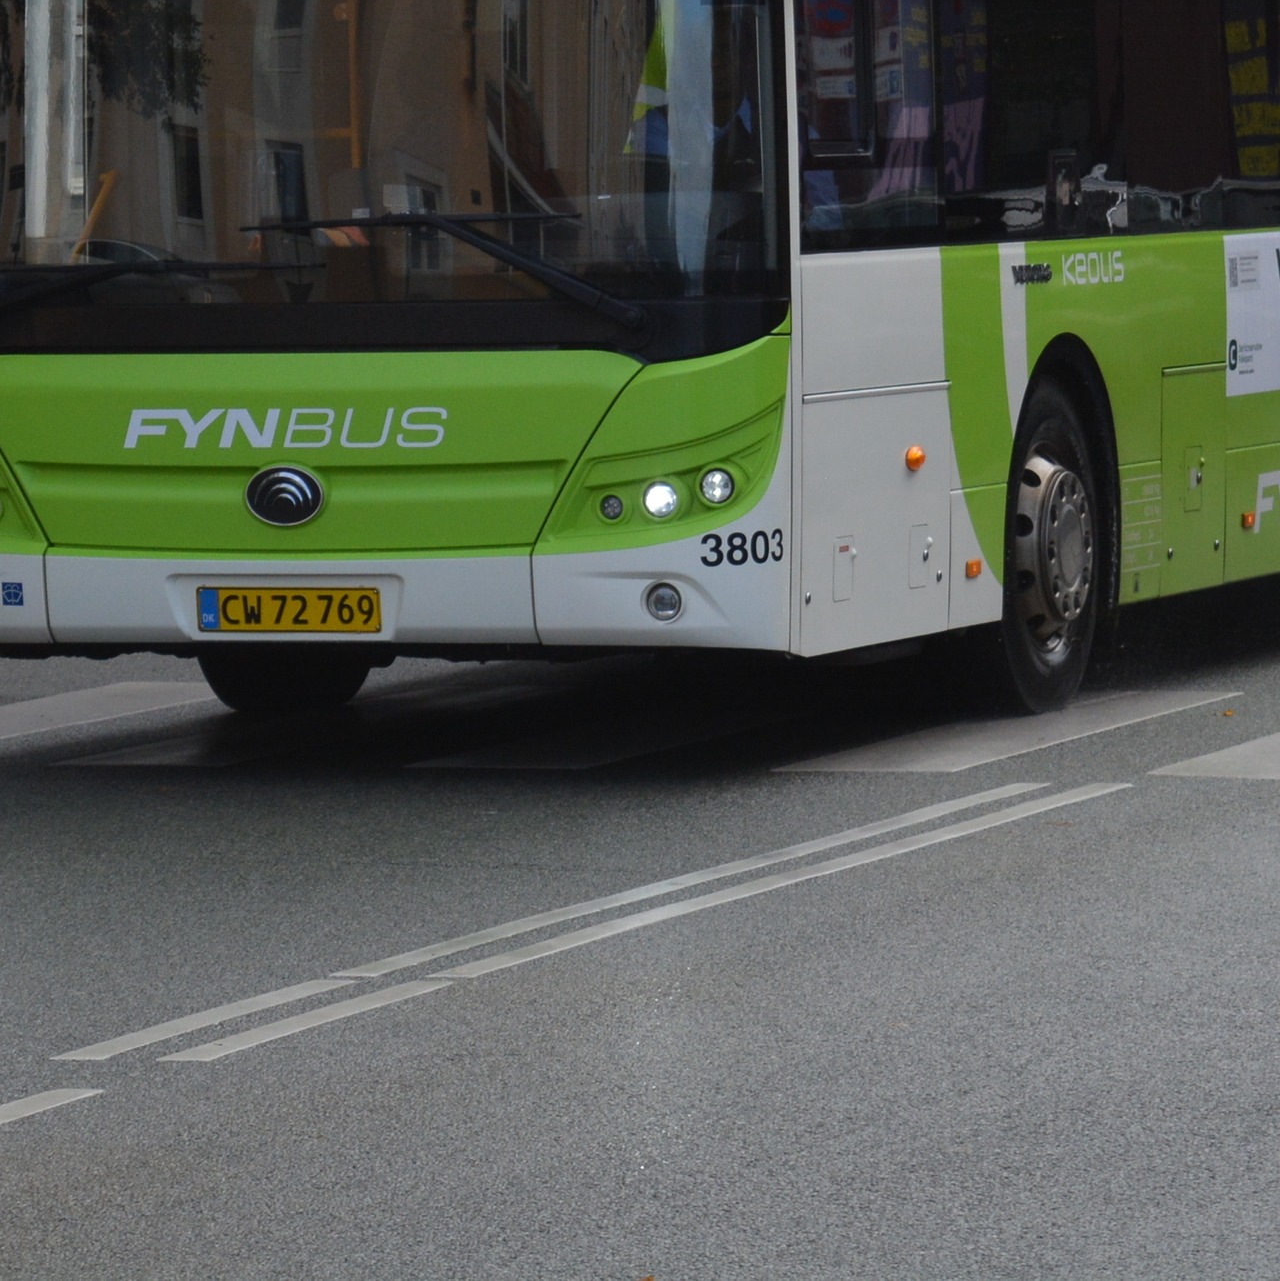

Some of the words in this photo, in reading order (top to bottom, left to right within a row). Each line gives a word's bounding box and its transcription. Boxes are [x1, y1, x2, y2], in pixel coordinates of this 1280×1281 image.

[123, 407, 449, 449] FYNBUS
[699, 527, 785, 569] 3803
[202, 613, 215, 623] DK
[221, 594, 262, 625] CW
[271, 594, 309, 625] 72
[317, 594, 375, 625] 769
